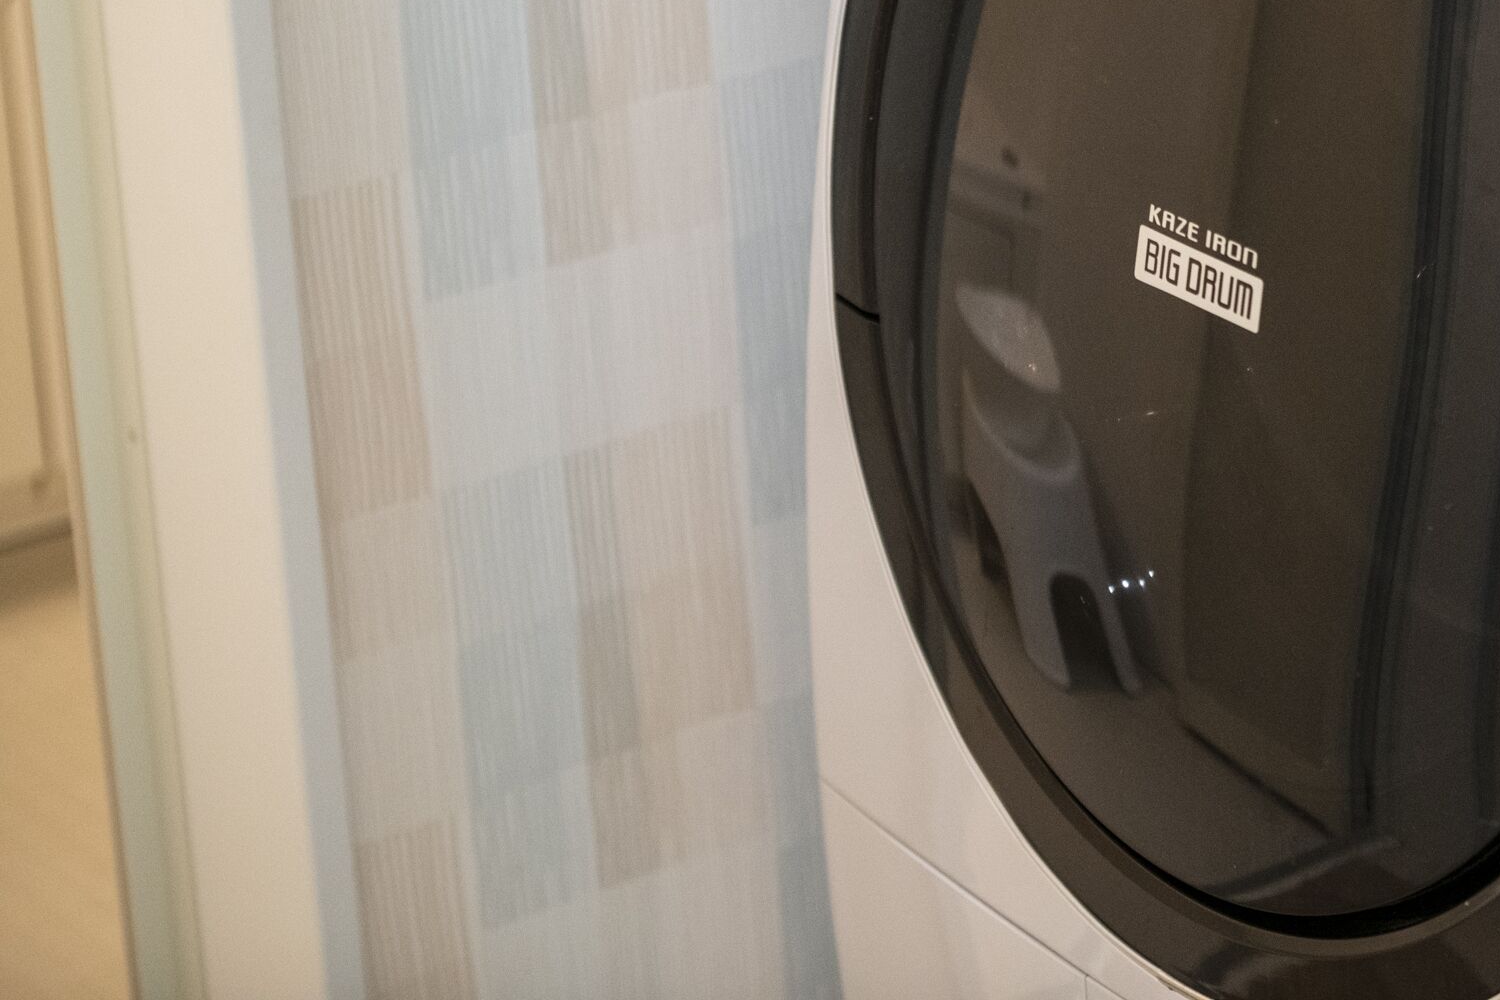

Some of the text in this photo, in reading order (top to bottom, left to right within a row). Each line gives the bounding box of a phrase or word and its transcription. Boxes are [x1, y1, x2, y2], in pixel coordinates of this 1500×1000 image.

[1148, 203, 1258, 270] KAZE IRON
[1144, 238, 1254, 320] BIG DRUM
